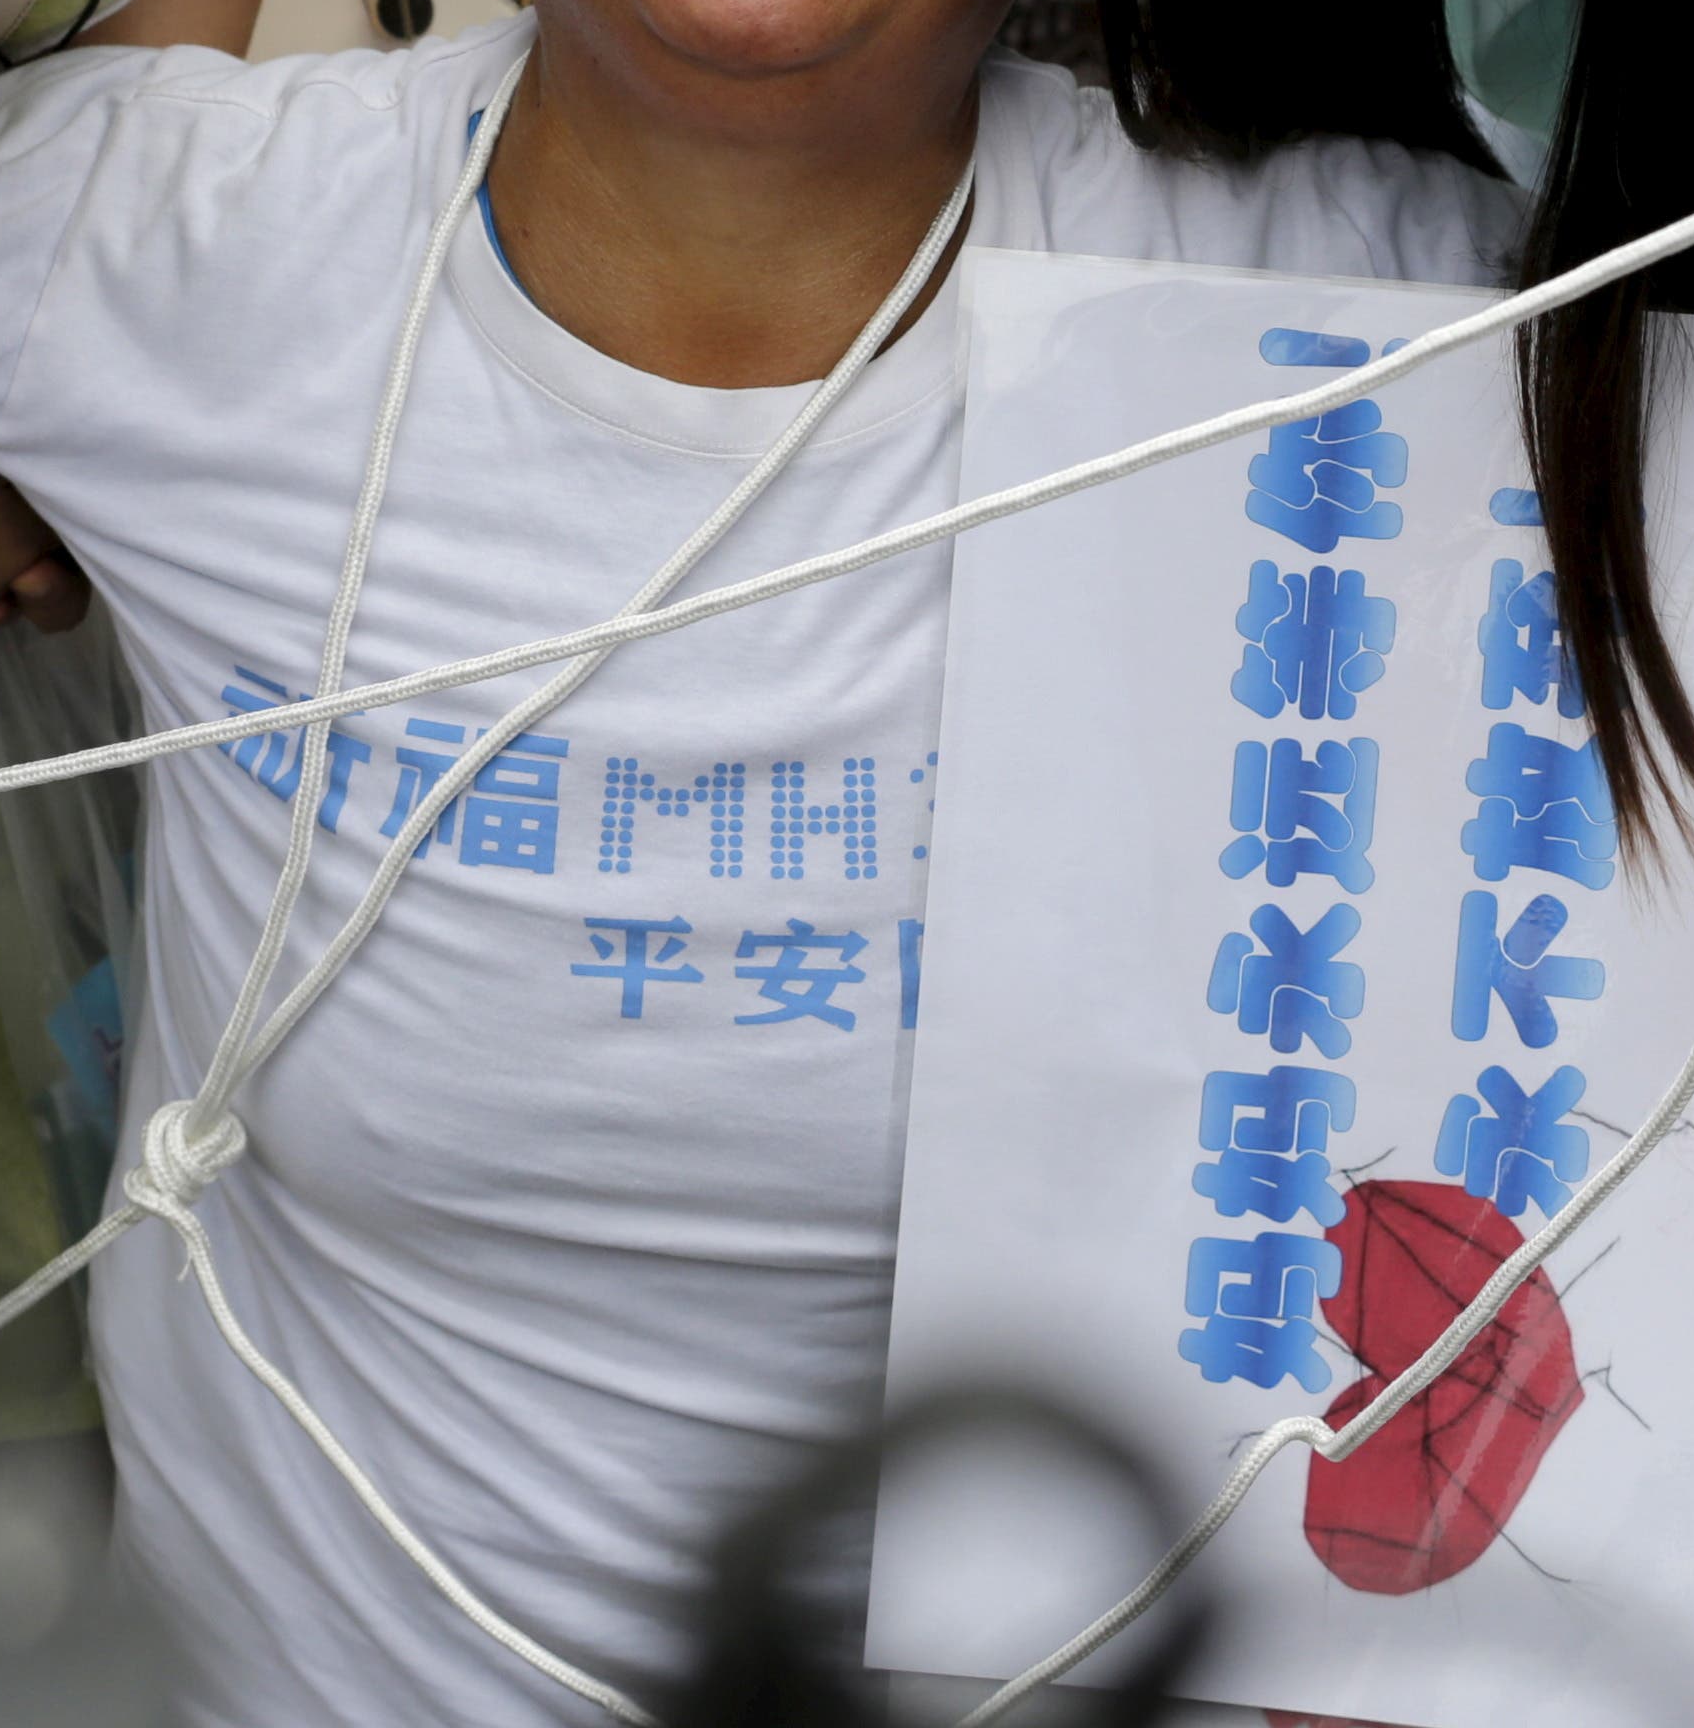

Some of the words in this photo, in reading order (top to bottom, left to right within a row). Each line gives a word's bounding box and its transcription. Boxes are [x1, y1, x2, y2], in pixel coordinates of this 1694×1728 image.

[569, 915, 925, 1033] 平安
[1177, 326, 1410, 1395] 妈妈永远等你！
